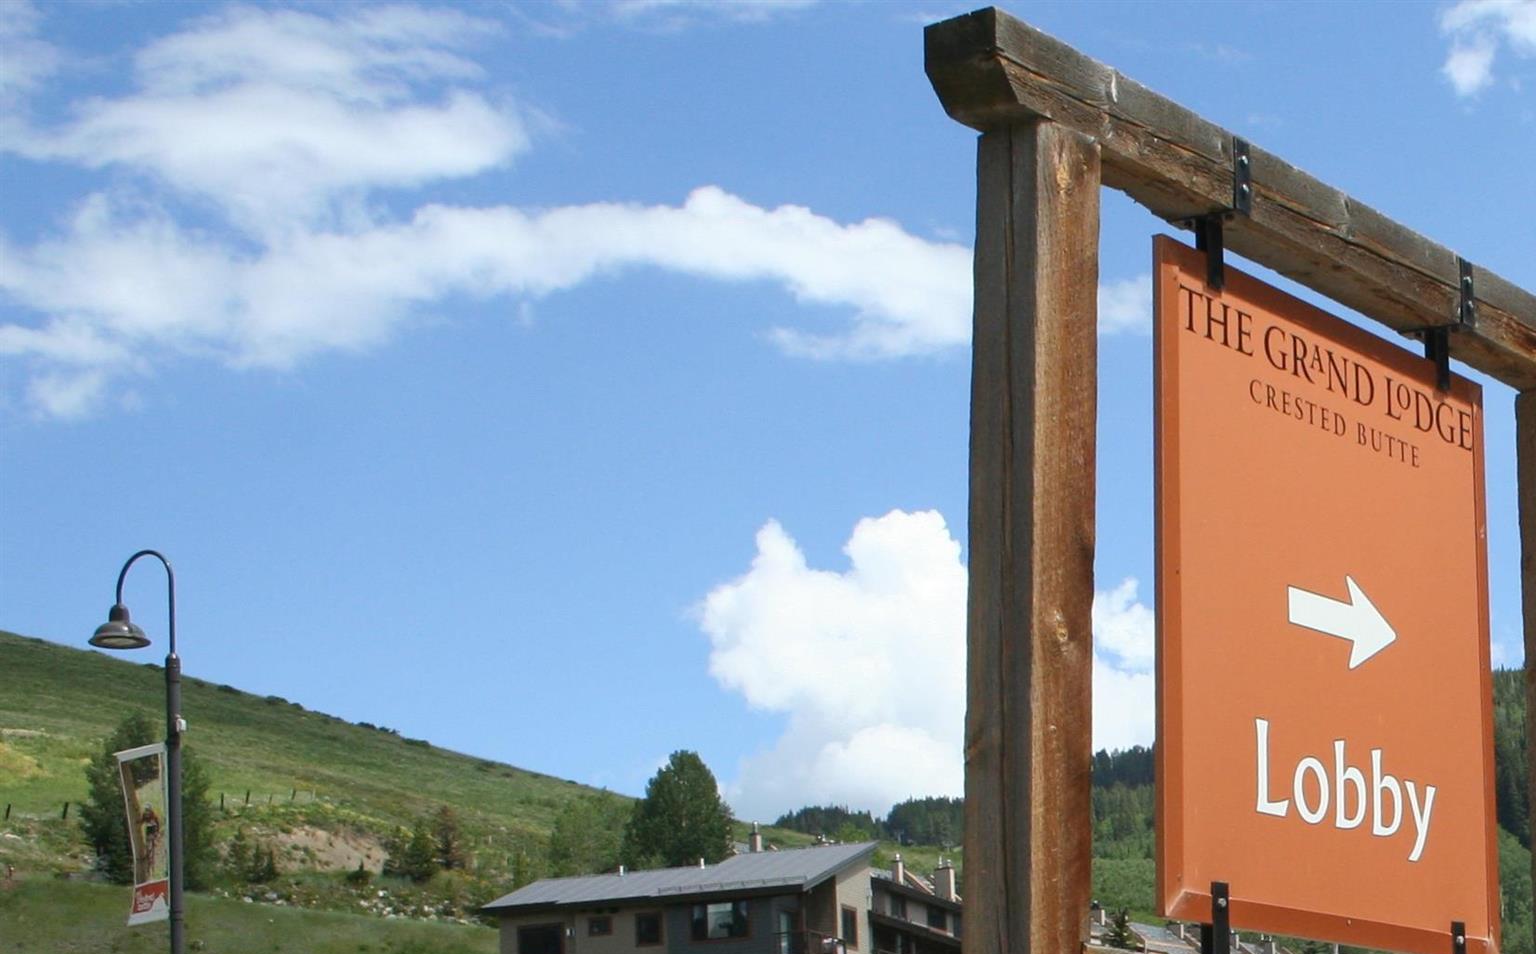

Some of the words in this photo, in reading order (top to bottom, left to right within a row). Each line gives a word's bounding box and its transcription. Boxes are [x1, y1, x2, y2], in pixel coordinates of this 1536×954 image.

[1179, 284, 1253, 357] THE
[1264, 325, 1375, 407] GRAND
[1385, 375, 1472, 452] LODGE
[1250, 378, 1346, 437] CRESTED
[1357, 422, 1420, 468] BUTTE
[1255, 716, 1437, 863] Lobby
